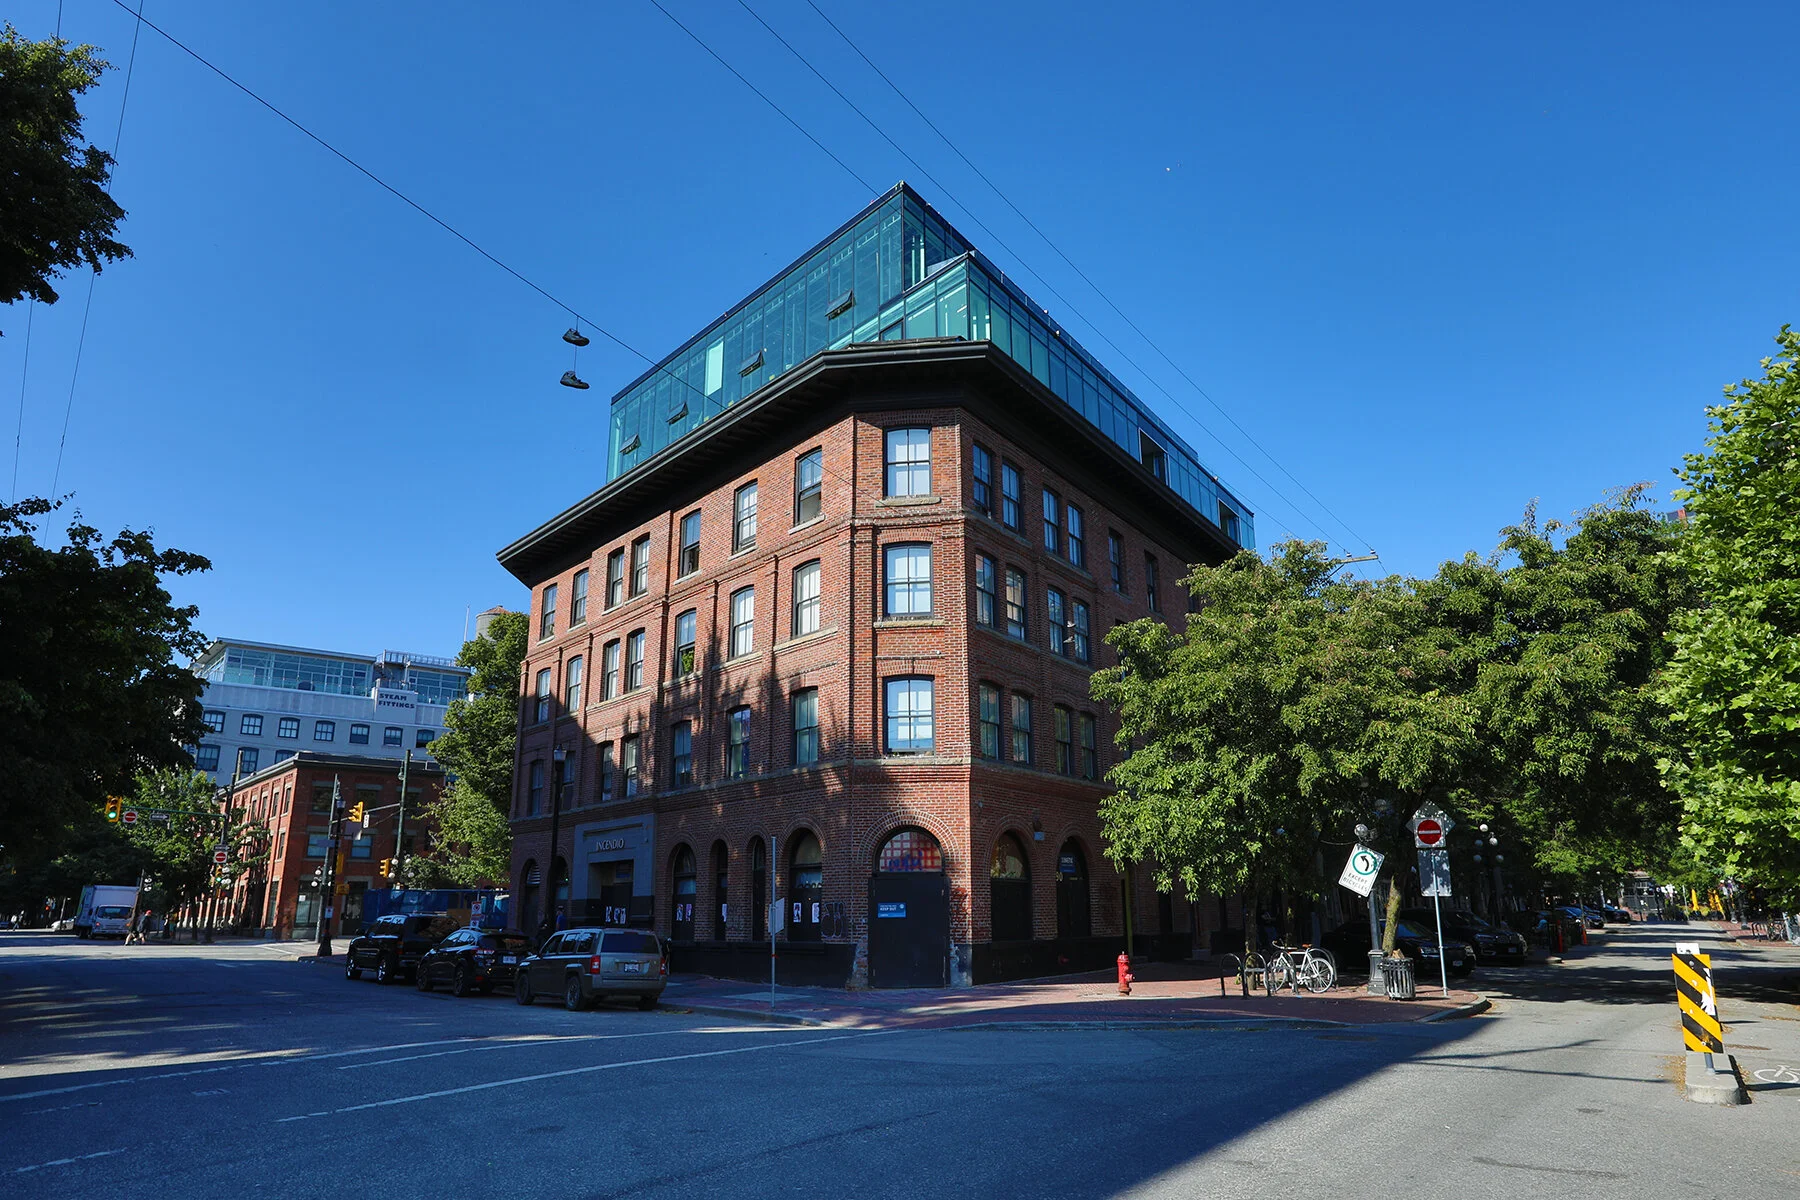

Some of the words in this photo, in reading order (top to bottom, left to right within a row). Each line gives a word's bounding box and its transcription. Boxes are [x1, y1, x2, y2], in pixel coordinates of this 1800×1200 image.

[379, 693, 407, 701] STEAM
[378, 700, 415, 709] FITTINGS
[596, 837, 624, 851] INCENDIO
[1342, 876, 1368, 892] BICYCLES
[1348, 872, 1368, 884] EXCEPT
